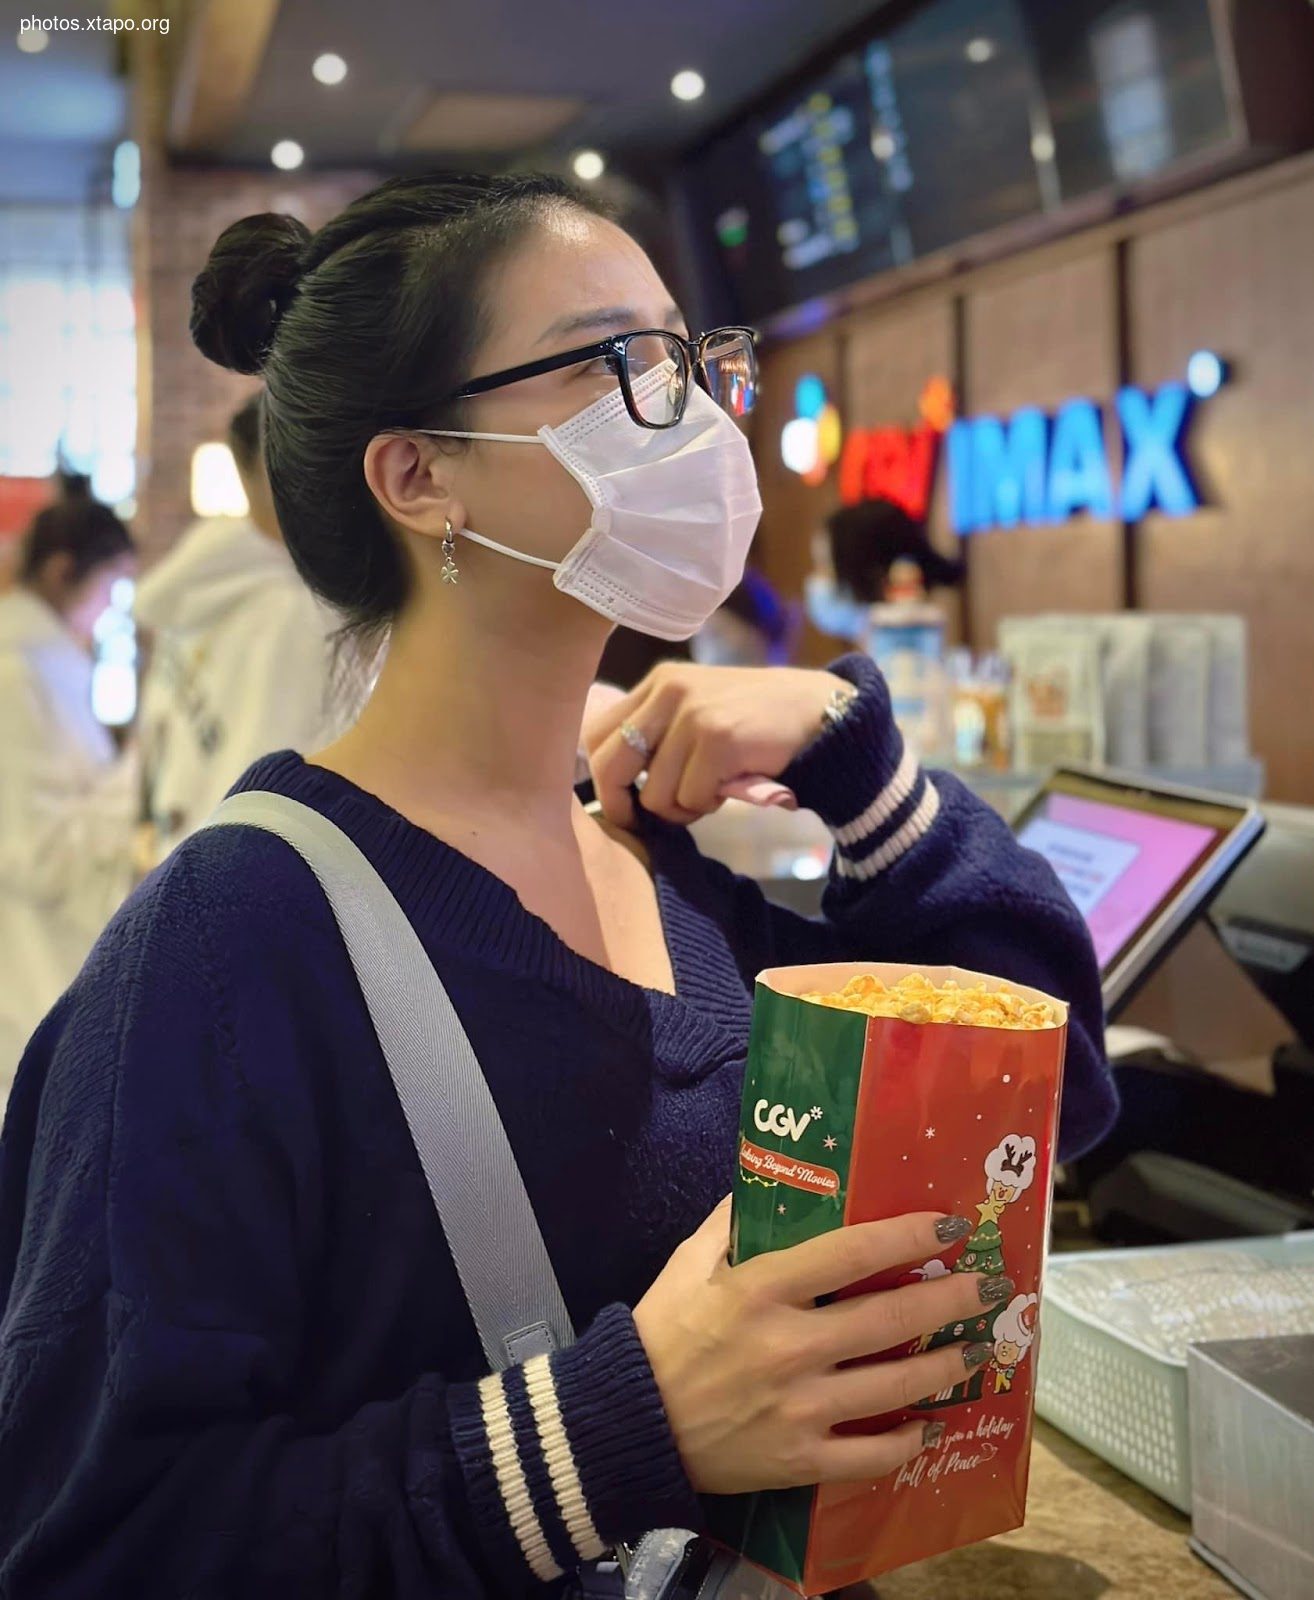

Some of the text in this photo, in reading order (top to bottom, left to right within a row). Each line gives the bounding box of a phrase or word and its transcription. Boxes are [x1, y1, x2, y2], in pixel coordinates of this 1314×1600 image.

[947, 381, 1199, 536] IMAX
[754, 1099, 811, 1142] CGV
[763, 1154, 797, 1177] Beyond
[797, 1166, 836, 1188] Movies
[943, 1431, 965, 1453] you
[976, 1414, 1014, 1439] holiday
[927, 1454, 945, 1483] of
[944, 1451, 981, 1476] Peace
